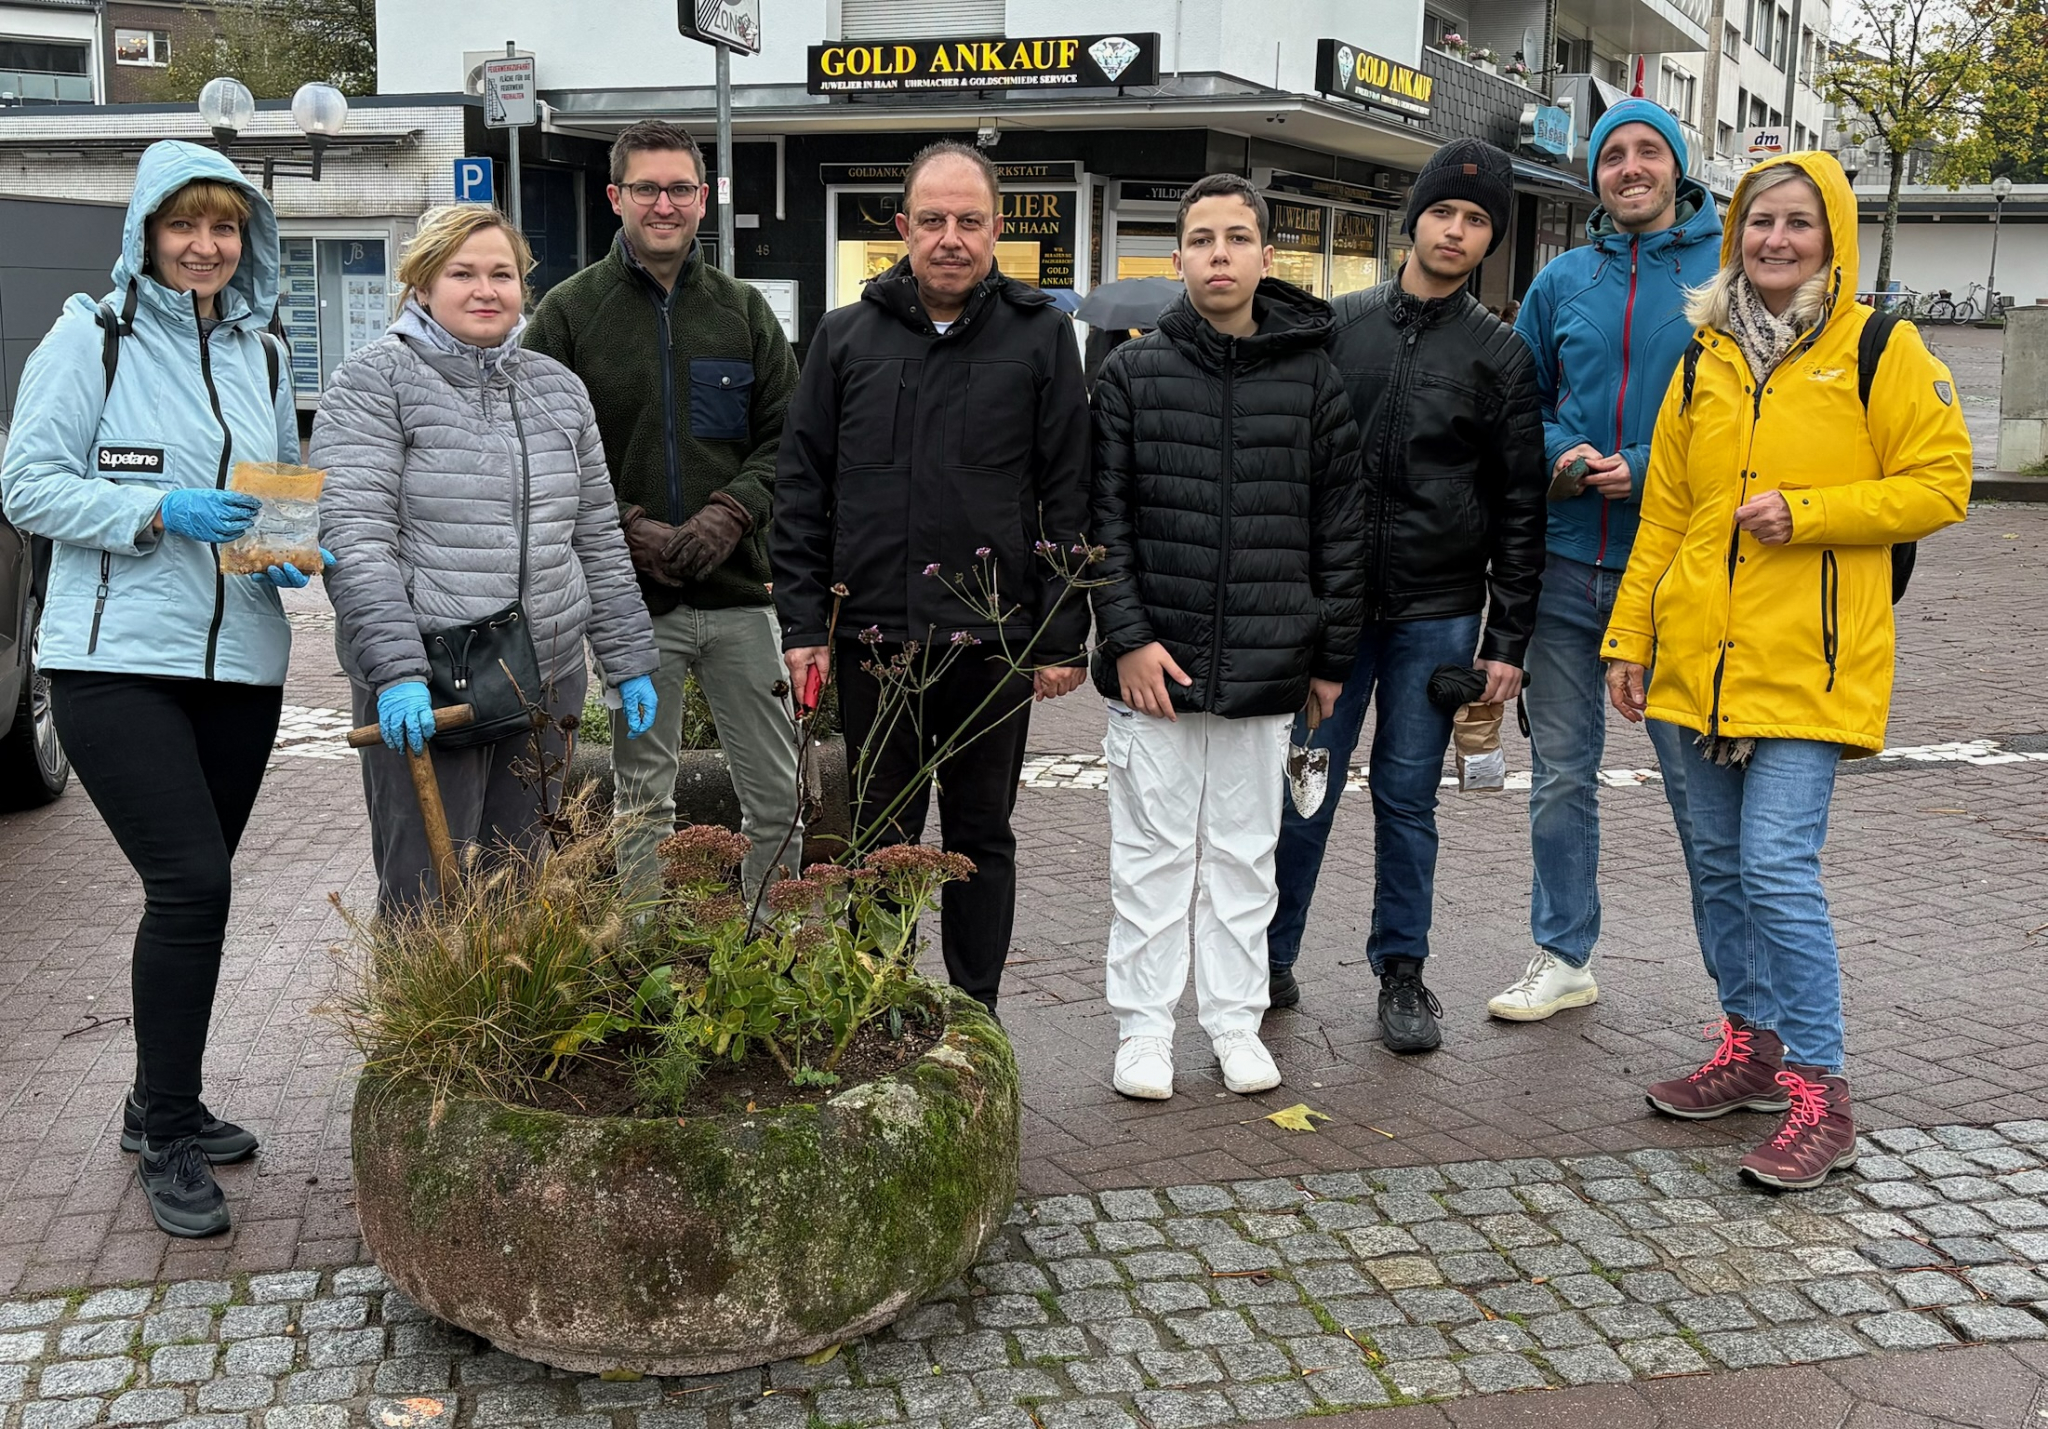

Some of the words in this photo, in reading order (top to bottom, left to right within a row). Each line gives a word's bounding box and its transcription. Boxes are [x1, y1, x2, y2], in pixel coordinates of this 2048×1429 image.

[820, 45, 917, 76] GOLD
[929, 39, 1079, 73] ANKAUF
[820, 80, 862, 90] JUWELIER
[863, 80, 873, 89] IN
[874, 80, 898, 89] HAAN
[905, 77, 959, 88] UHRMACHER
[960, 77, 967, 86] &
[969, 75, 1038, 86] GOLDSCHMIEDE
[1039, 74, 1078, 84] SERVICE
[1355, 52, 1389, 88] GOLD
[1389, 64, 1433, 102] ANKAUF
[1754, 131, 1779, 146] dm
[848, 167, 907, 178] GOLDANKA
[998, 165, 1048, 176] RKSTATT
[462, 164, 483, 199] P
[998, 194, 1061, 218] LIER
[1273, 204, 1321, 233] JUWELIER
[1019, 221, 1060, 234] HAAN
[1046, 267, 1069, 275] GOLD
[1041, 277, 1074, 285] ANKAUF
